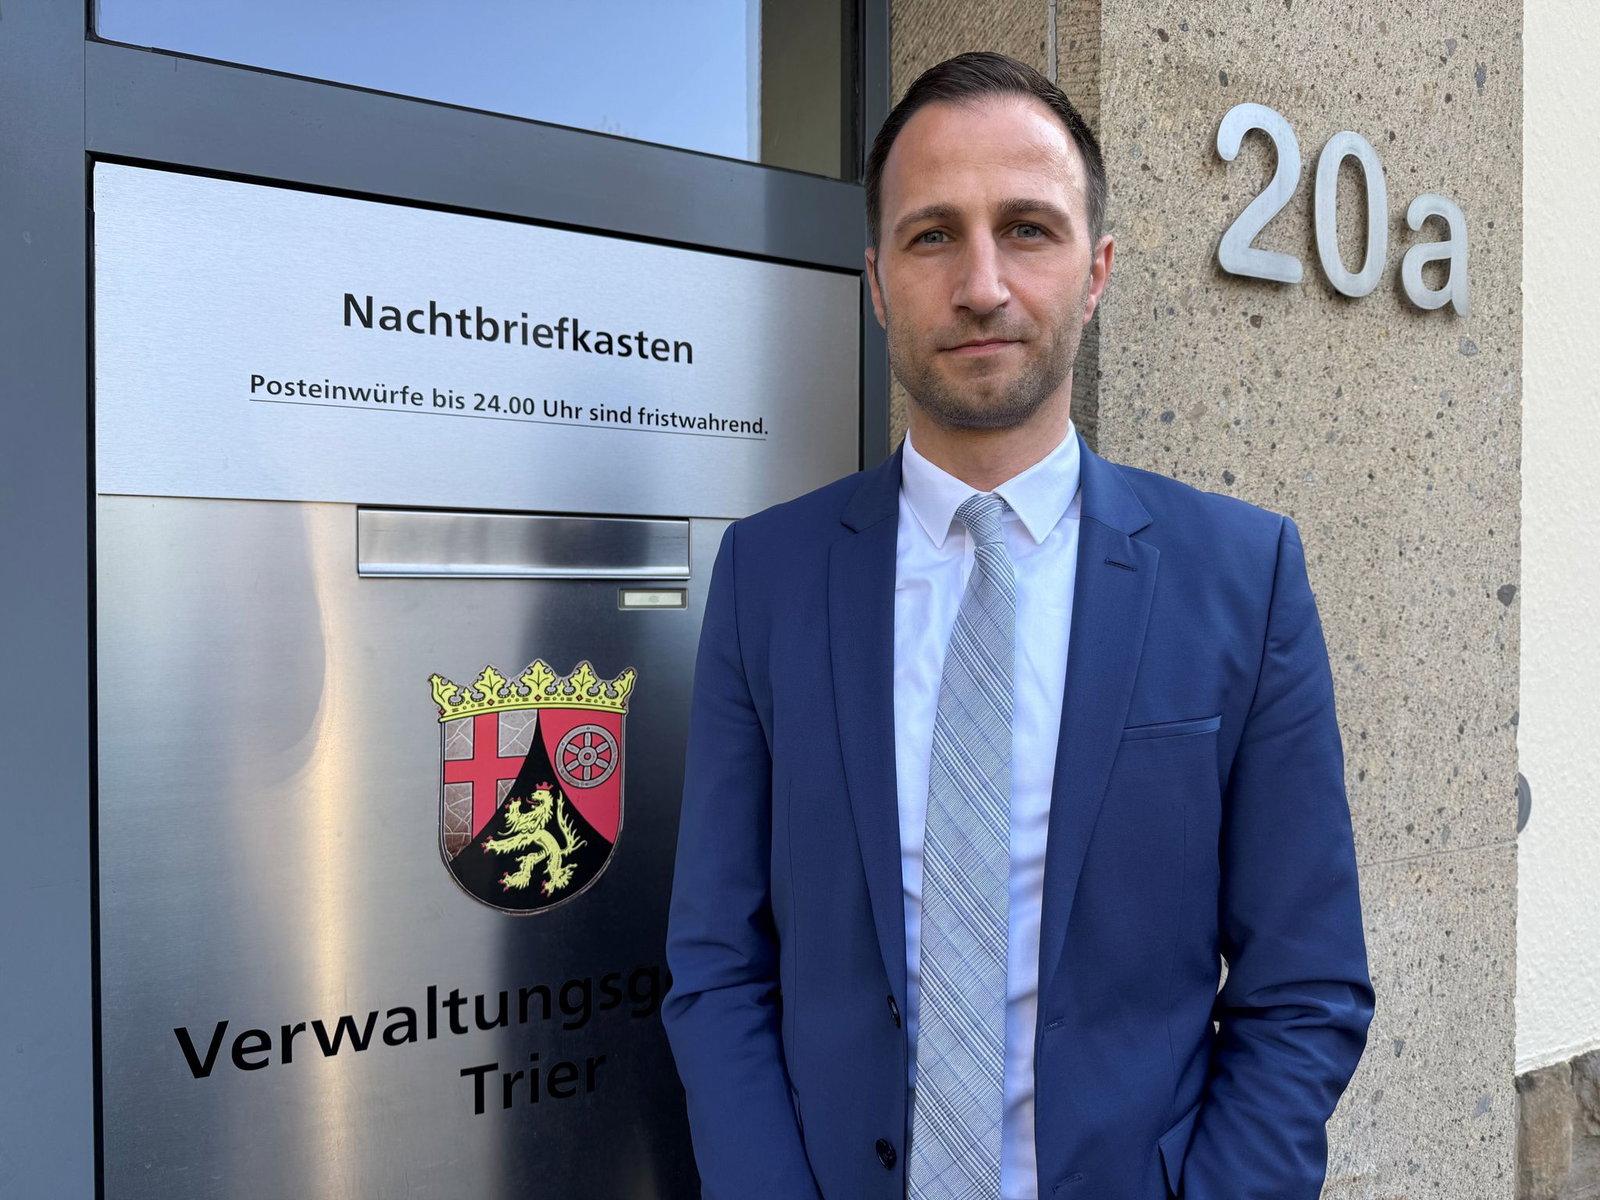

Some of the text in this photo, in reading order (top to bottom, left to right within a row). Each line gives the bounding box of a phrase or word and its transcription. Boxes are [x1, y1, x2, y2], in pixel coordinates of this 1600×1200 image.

[1217, 103, 1469, 318] 20a
[343, 292, 694, 364] Nachtbriefkasten
[250, 374, 769, 435] Posteinwürfe bis 24.00 Uhr sind fristwahrend.
[173, 964, 673, 1080] Verwaltungsg
[460, 1052, 607, 1115] Trier
